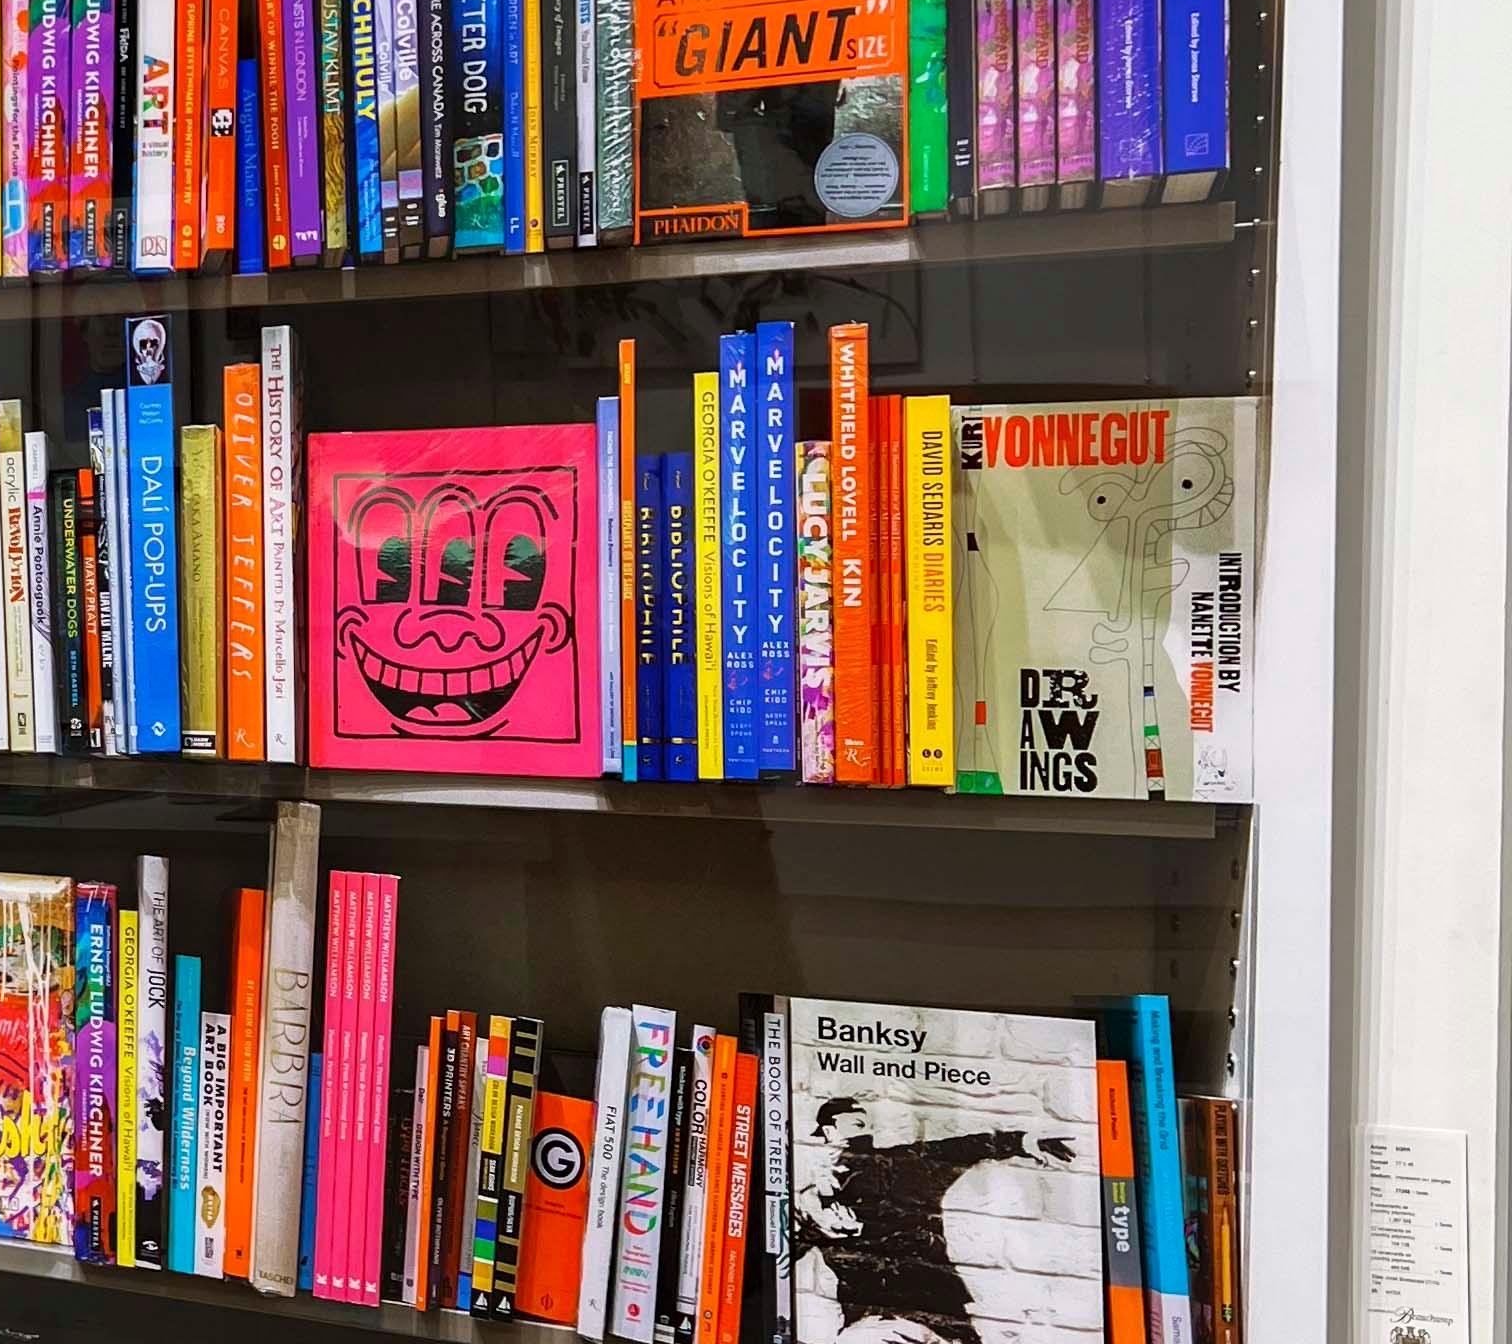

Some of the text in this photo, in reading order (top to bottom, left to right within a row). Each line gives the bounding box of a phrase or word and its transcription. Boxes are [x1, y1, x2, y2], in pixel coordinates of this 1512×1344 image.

[142, 55, 170, 135] ART
[217, 8, 231, 90] CANVAS
[323, 58, 343, 114] KLIMT
[377, 41, 392, 95] Colville
[463, 59, 489, 114] DOIG
[846, 35, 888, 62] SIZE
[41, 75, 55, 182] KIRCHNER
[84, 71, 100, 178] KIRCHNER
[653, 214, 739, 237] PHAIDON
[767, 349, 785, 635] MARVELOCITY
[839, 343, 862, 608] WHITFIELD LOVELL KIN
[960, 416, 983, 470] KURT
[982, 410, 1171, 468] VONNEGUT
[140, 456, 169, 632] DALÍ POP-UPS
[232, 392, 255, 679] OLIVER JEFFERS
[729, 362, 748, 646] MARVELOCITY
[921, 431, 945, 613] DAVID SEDARIS DIARIES
[801, 473, 830, 690] LUCY JARVIS
[1218, 552, 1242, 693] INTRODUCTION BY
[1190, 591, 1214, 733] NANETTE VONNEGUT
[1020, 751, 1098, 793] INGS
[147, 890, 166, 1009] THE ART OF JOCK
[88, 924, 104, 1177] ERNST LUDWIG KIRCHNER
[203, 1023, 215, 1107] ART BOOK
[268, 968, 310, 1126] BARBRA
[817, 1016, 928, 1055] Banksy
[817, 1051, 992, 1087] Wall and Piece
[179, 1046, 196, 1191] Beyond Wilderness
[213, 1025, 226, 1173] A BIG IMPORTANT
[690, 1079, 708, 1188] COLOR HARMONY
[768, 1019, 782, 1185] THE BOOK OF TREES
[728, 1104, 751, 1238] STREET MESSAGES
[1111, 1205, 1130, 1253] type
